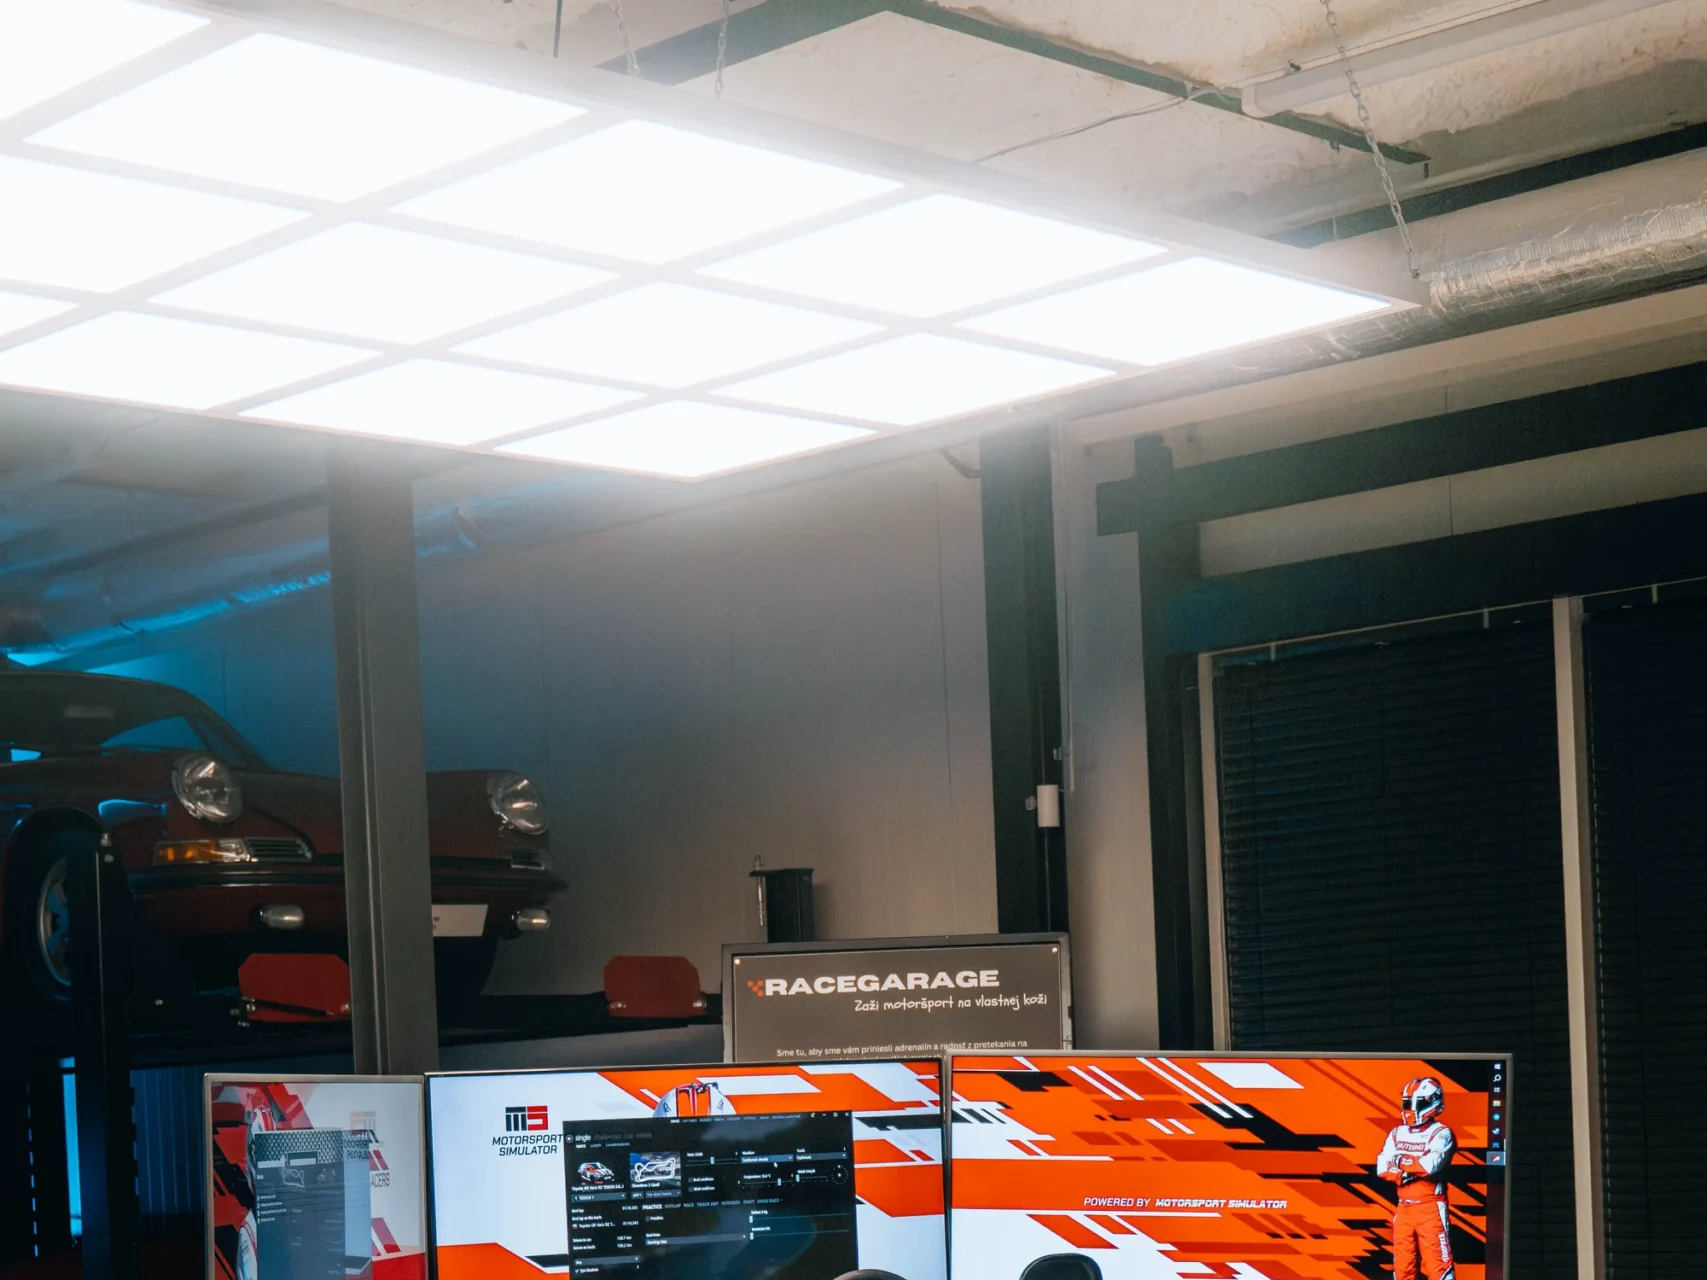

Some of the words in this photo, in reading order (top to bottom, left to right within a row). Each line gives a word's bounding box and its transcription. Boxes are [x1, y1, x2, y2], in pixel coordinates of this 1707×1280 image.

[765, 970, 999, 996] RACEGARAGE
[854, 1000, 879, 1012] Zaži
[883, 996, 954, 1013] motoršport
[958, 999, 972, 1008] na
[975, 994, 1020, 1011] vlastnej
[1023, 993, 1048, 1006] koži
[777, 1049, 794, 1057] Sme
[795, 1048, 807, 1057] tu,
[808, 1047, 823, 1057] aby
[824, 1047, 841, 1055] sme
[842, 1045, 860, 1054] vám
[861, 1044, 893, 1056] priniesli
[894, 1042, 932, 1052] adrenalín
[973, 1040, 1016, 1051] pretekania
[492, 1133, 563, 1146] MOTORSPORT
[499, 1145, 558, 1157] SIMULATOR
[1084, 1197, 1134, 1207] POWERED
[1136, 1198, 1150, 1207] BY
[1155, 1199, 1226, 1208] MOTORSPORT
[1228, 1199, 1287, 1209] SIMULATOR
